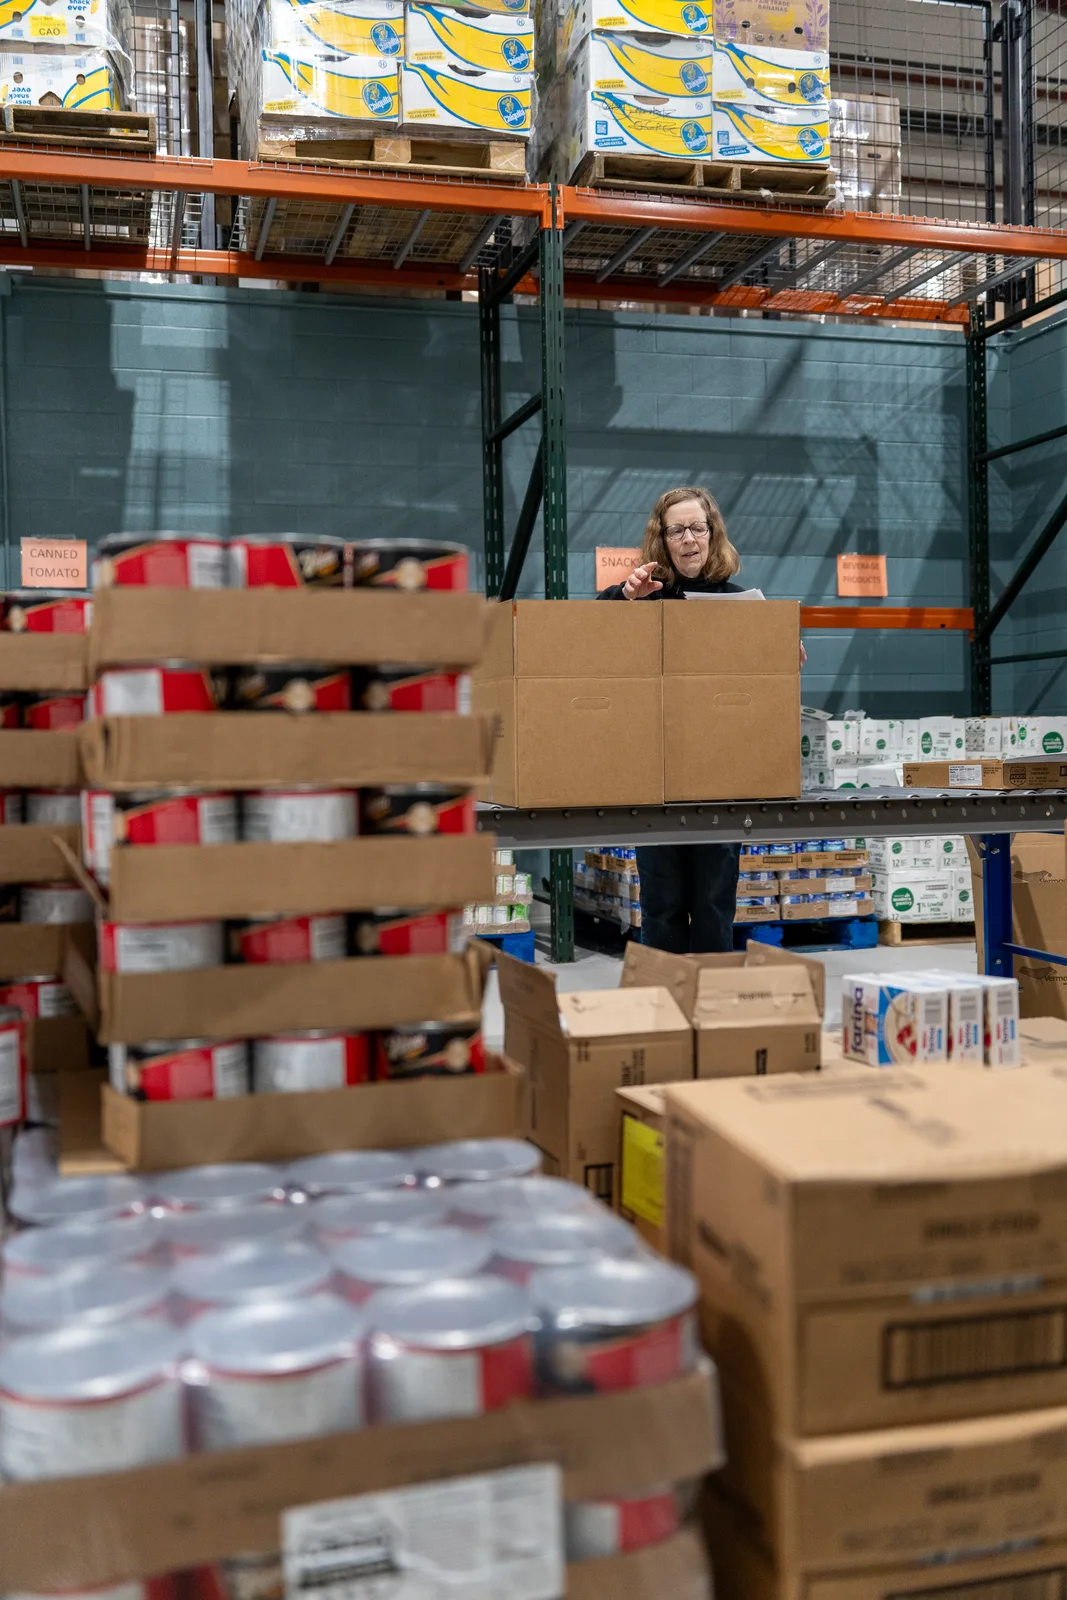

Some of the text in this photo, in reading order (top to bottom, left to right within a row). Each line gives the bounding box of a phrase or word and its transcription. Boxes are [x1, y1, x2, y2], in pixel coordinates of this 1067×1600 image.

[30, 548, 78, 559] CANNED
[29, 567, 80, 578] TOMATO
[842, 576, 881, 584] PRODUCTS
[892, 860, 900, 868] 12
[944, 858, 951, 866] 12
[958, 908, 966, 916] 12
[851, 988, 865, 1056] farina
